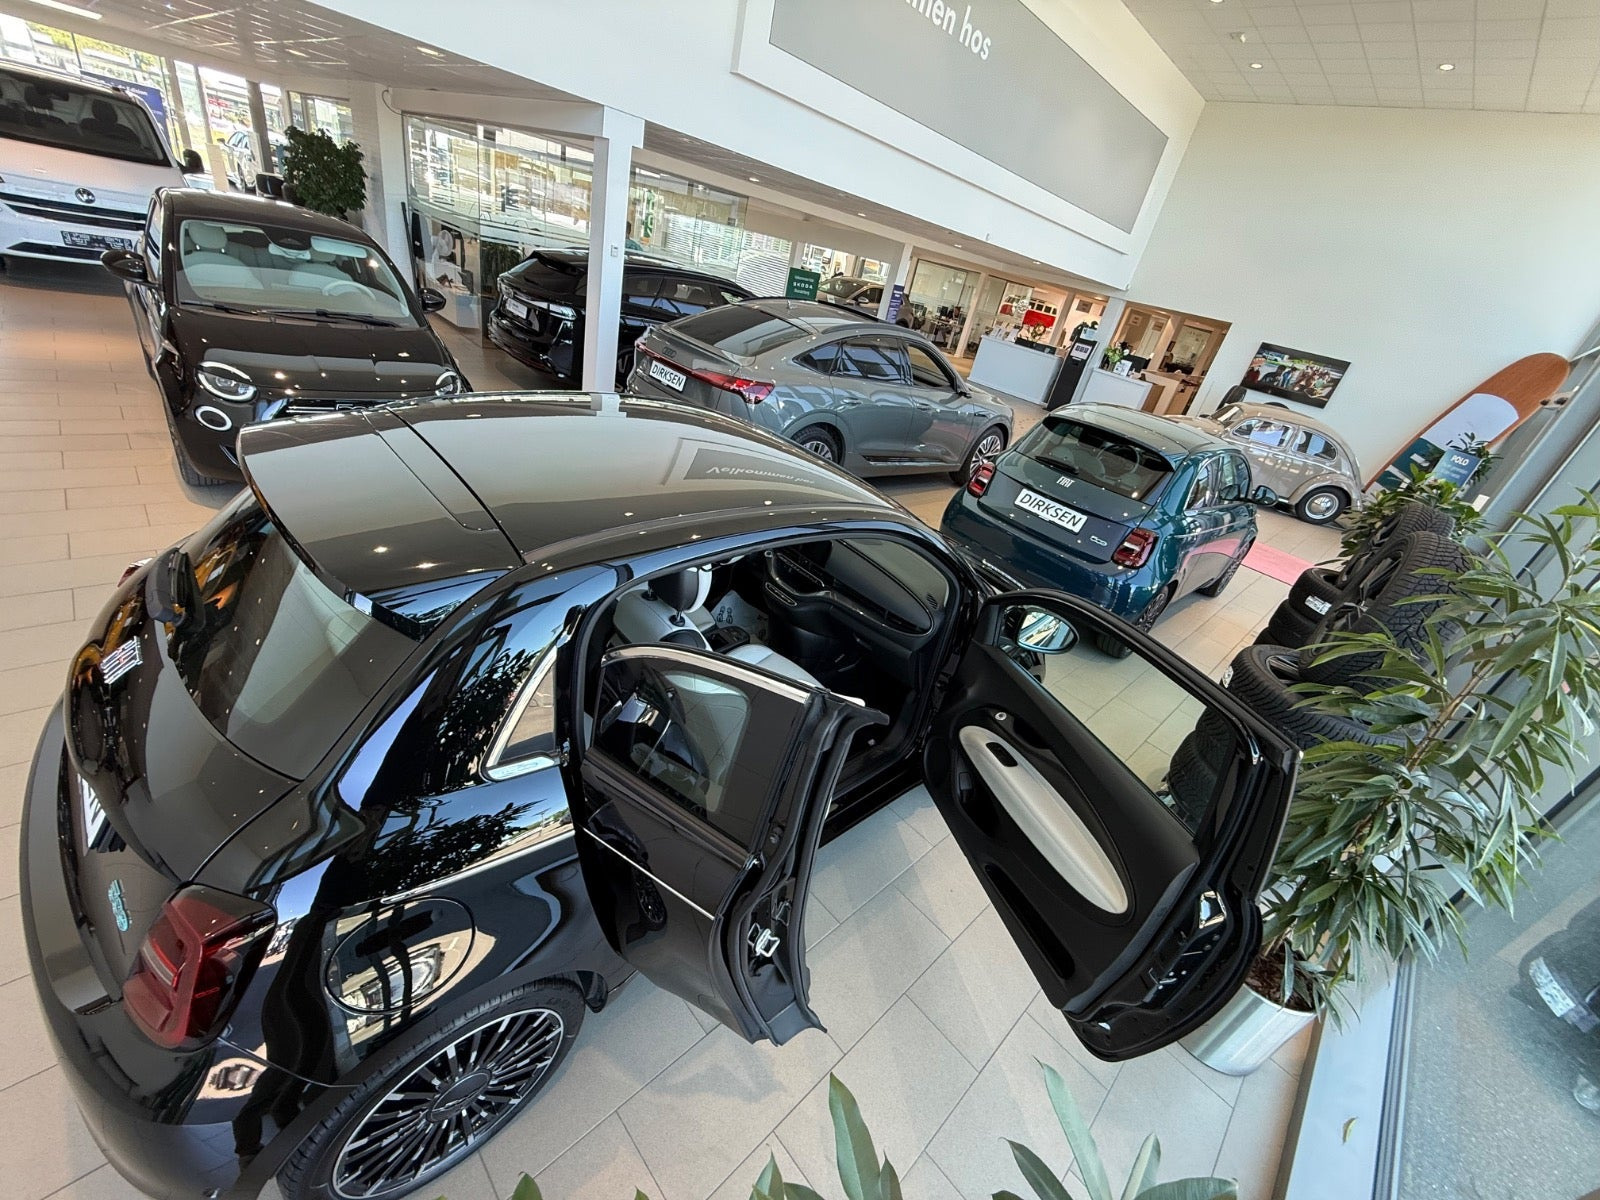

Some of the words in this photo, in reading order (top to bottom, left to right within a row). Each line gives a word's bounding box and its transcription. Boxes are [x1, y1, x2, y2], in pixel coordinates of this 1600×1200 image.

[959, 4, 992, 60] hos
[651, 364, 684, 387] DIRKSEN
[1450, 454, 1470, 466] POLO
[1056, 475, 1076, 488] FIAT
[1020, 494, 1083, 527] DIRKSEN
